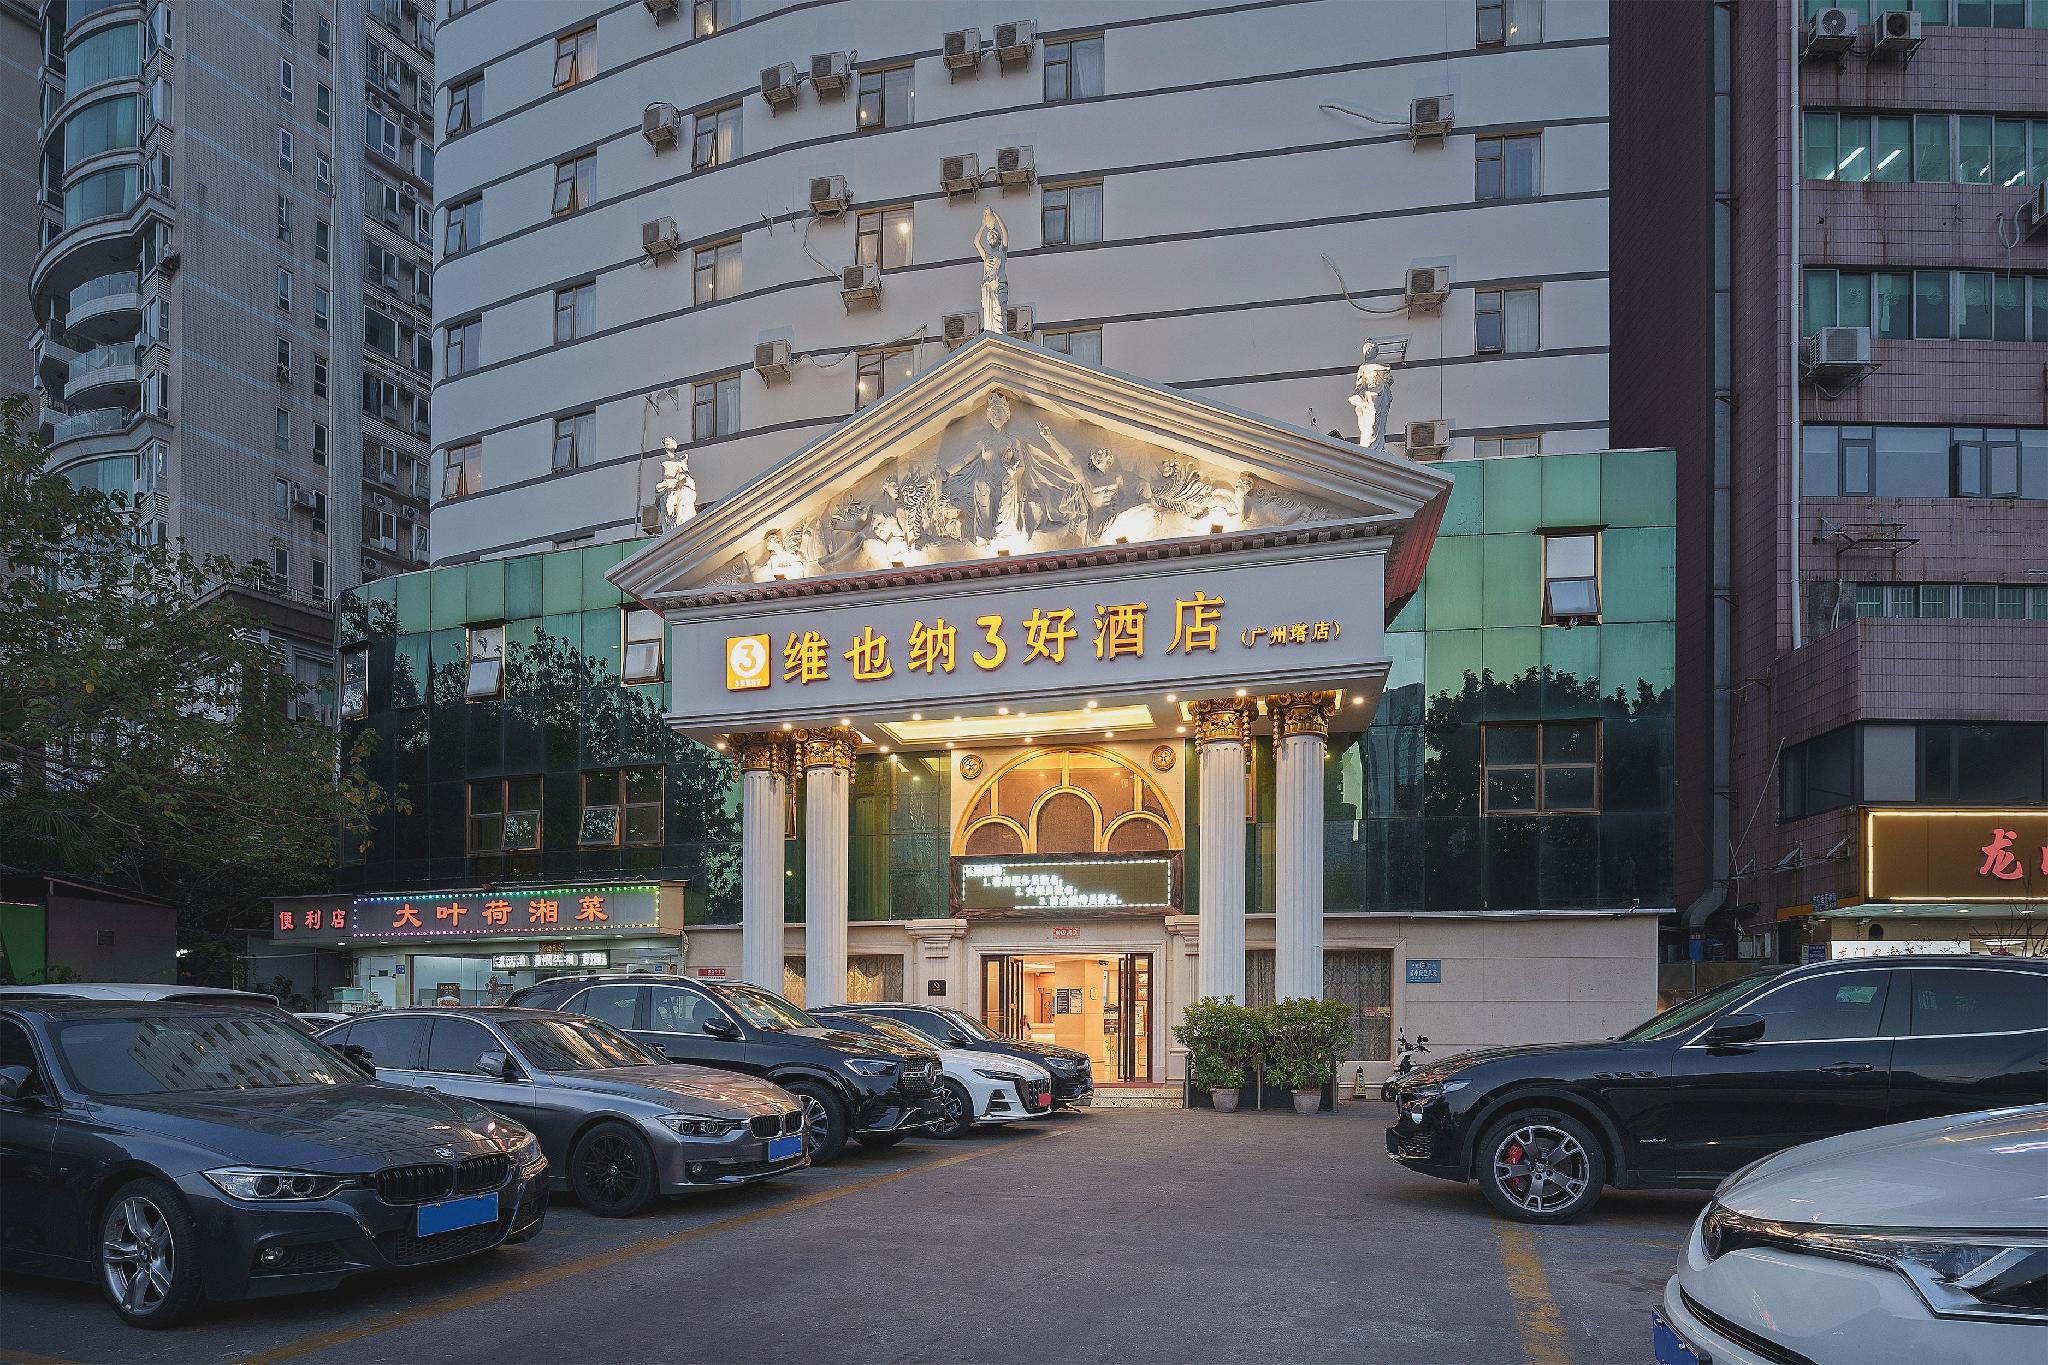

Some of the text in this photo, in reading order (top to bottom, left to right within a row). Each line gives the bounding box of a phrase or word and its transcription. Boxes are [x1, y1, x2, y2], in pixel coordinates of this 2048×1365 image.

[782, 590, 1225, 685] 维也纳3好酒店
[1979, 828, 2048, 880] 龙
[278, 909, 347, 931] 便利店
[391, 895, 610, 929] 大叶荷湘菜
